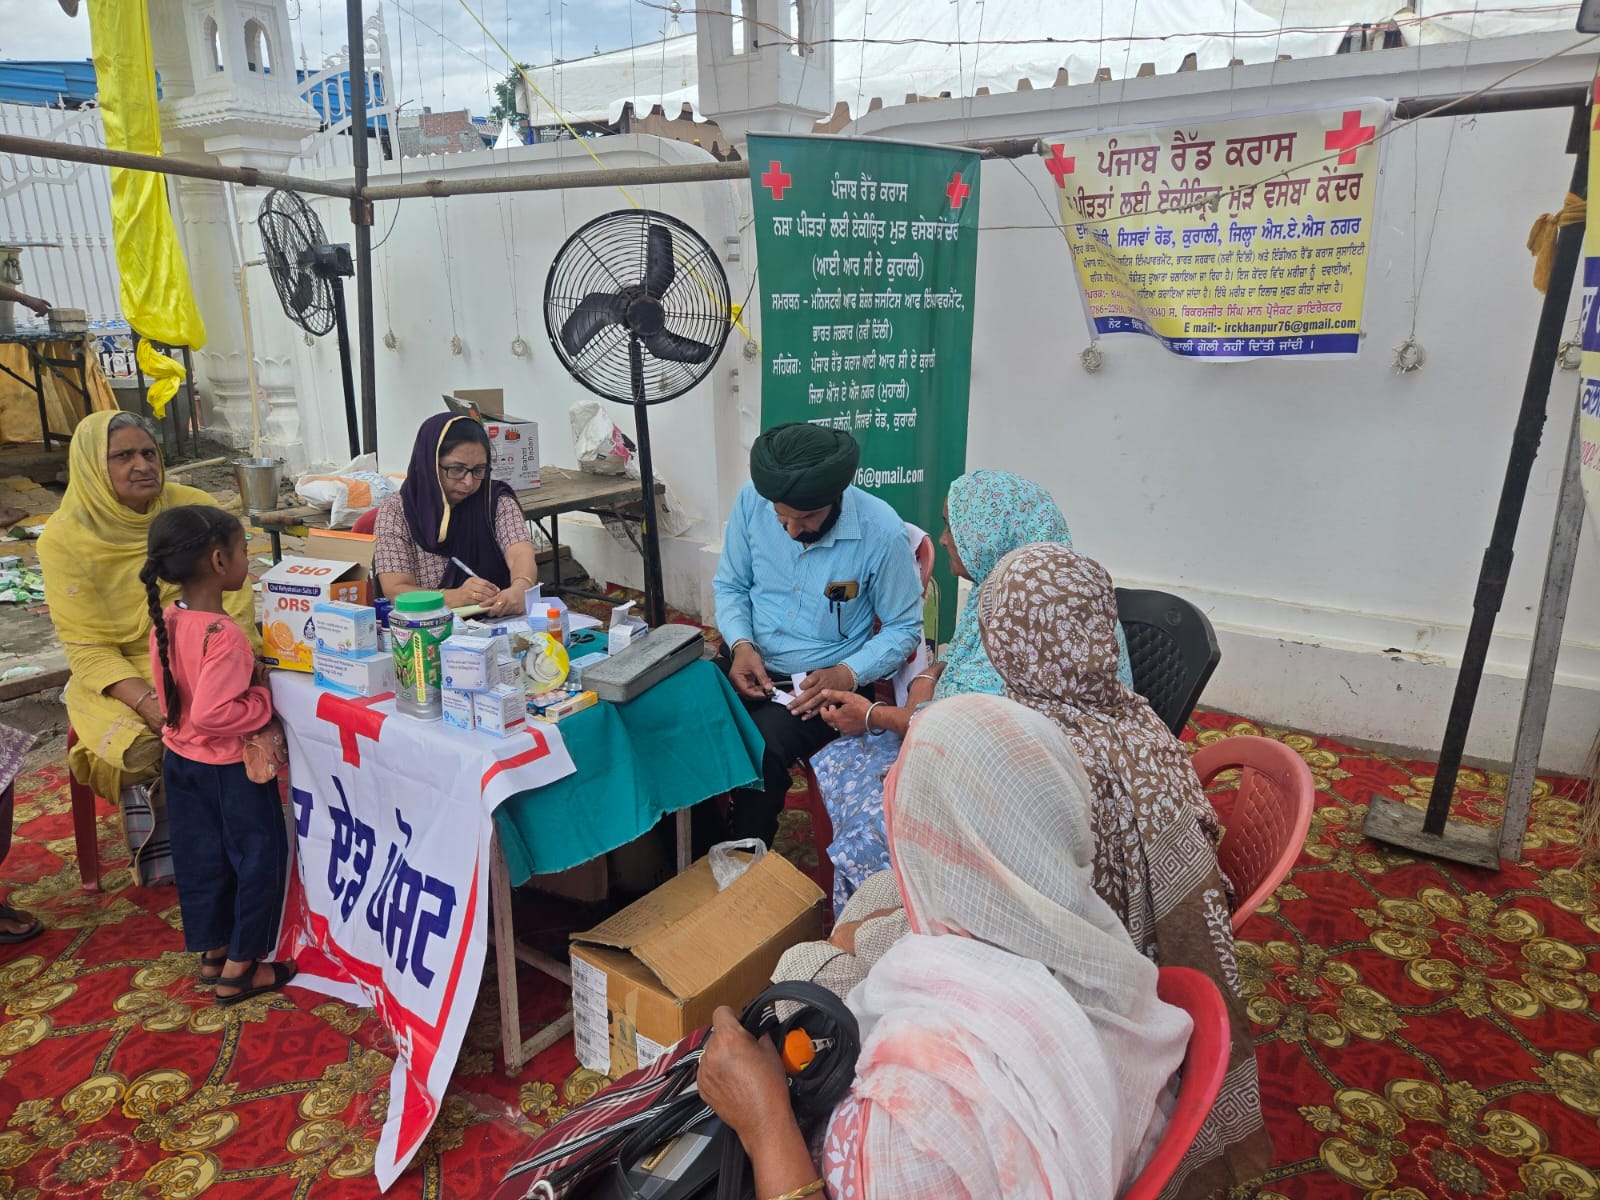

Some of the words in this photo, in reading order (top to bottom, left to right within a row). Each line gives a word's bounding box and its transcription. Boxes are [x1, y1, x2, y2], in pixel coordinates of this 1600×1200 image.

[1097, 138, 1160, 177] ਪੰਜਾਬ
[1171, 130, 1216, 172] ਰੈੱਡ
[1226, 132, 1297, 168] ਕਰਾਸ
[831, 171, 858, 200] ਪੰਜਾਬ
[860, 173, 876, 201] ਰੈੱਡ
[880, 182, 908, 203] ਕਰਾਸ
[1074, 185, 1114, 219] ਪੀੜਤਾਂ
[1120, 181, 1151, 215] ਲਈ
[1228, 184, 1257, 219] ਮੁੜ
[1264, 173, 1311, 209] ਵਸੇਬਾ
[1316, 165, 1364, 204] ਕੇਂਦਰ
[797, 209, 826, 238] ਪੀੜਤਾਂ
[830, 211, 848, 239] ਲਈ
[890, 221, 907, 245] ਮੁੜ
[1117, 226, 1151, 248] ਸਿਸਵਾਂ
[1155, 224, 1176, 249] ਰੋਡ,
[1182, 222, 1223, 249] ਕੁਰਾਲੀ,
[1229, 219, 1257, 251] ਜਿਲ੍ਹਾ
[1330, 214, 1362, 237] ਨਗਰ
[812, 249, 840, 281] (ਆਈ
[843, 257, 859, 277] ਆਰ
[864, 251, 873, 277] ਸੀ
[875, 251, 882, 277] ਏ
[887, 251, 924, 282] ਕੁਰਾਲੀ)
[1195, 253, 1216, 264] ਸਰਕਾਰ
[1315, 247, 1334, 259] ਕਰਾਸ
[1237, 267, 1250, 280] ਇਸ
[1227, 304, 1244, 317] ਸਿੰਘ
[1247, 305, 1263, 317] ਮਾਨ
[1184, 321, 1190, 333] E
[1224, 318, 1356, 336] irckhanpur76@gmail.com
[1197, 338, 1218, 352] ਗੋਲੀ
[1223, 338, 1246, 352] ਨਹੀਂ
[1248, 338, 1275, 352] ਦਿੱਤੀ
[1279, 337, 1303, 351] ਜਾਂਦੀ
[811, 351, 829, 373] ਪੰਜਾਬ
[879, 353, 895, 369] ਆਰ
[898, 348, 908, 368] ਸੀ
[910, 349, 917, 369] ਏ
[875, 407, 890, 431] ਰੋਡ,
[893, 407, 917, 432] ਕੁਰਾਲੀ
[286, 565, 333, 576] ORS
[278, 597, 310, 612] ORS
